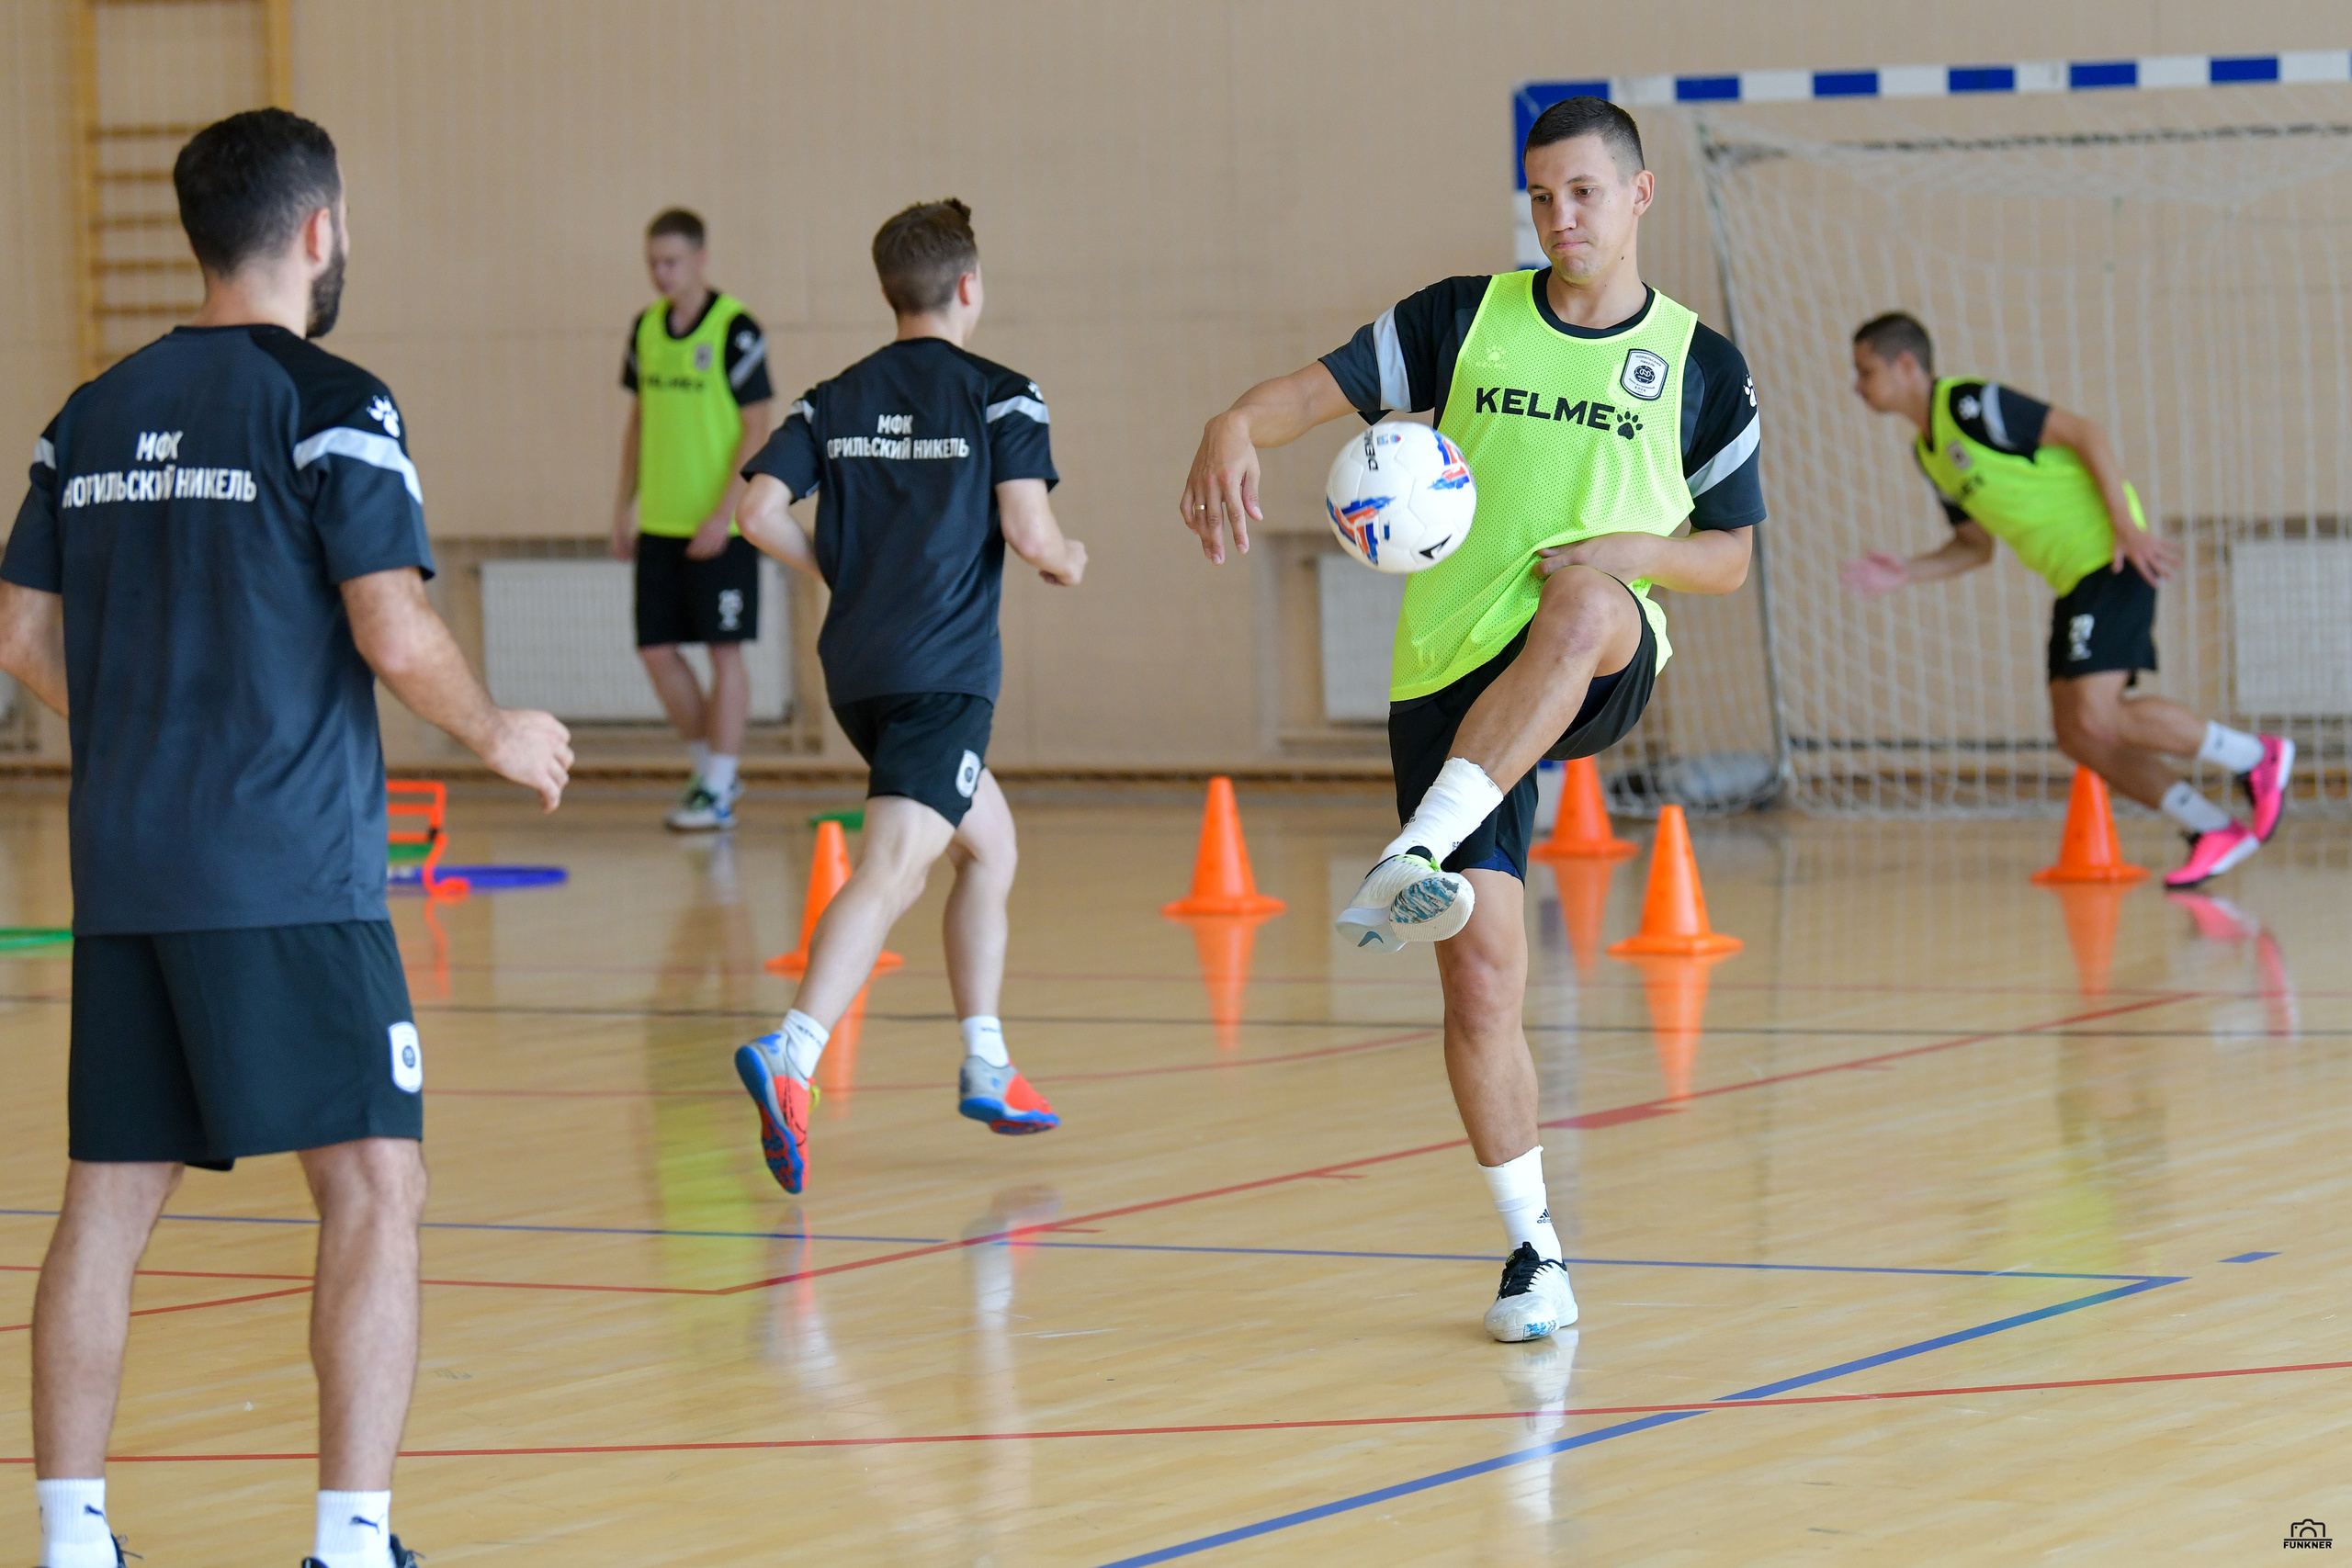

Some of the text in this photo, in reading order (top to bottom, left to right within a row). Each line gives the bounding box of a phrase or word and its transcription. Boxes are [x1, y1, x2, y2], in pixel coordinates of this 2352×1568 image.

[876, 413, 914, 435] МФК
[1476, 387, 1615, 432] KELME
[826, 436, 970, 460] ОРИЛЬСКИЙ НИКЕЛЬ
[174, 467, 258, 502] НИКЕЛЬ
